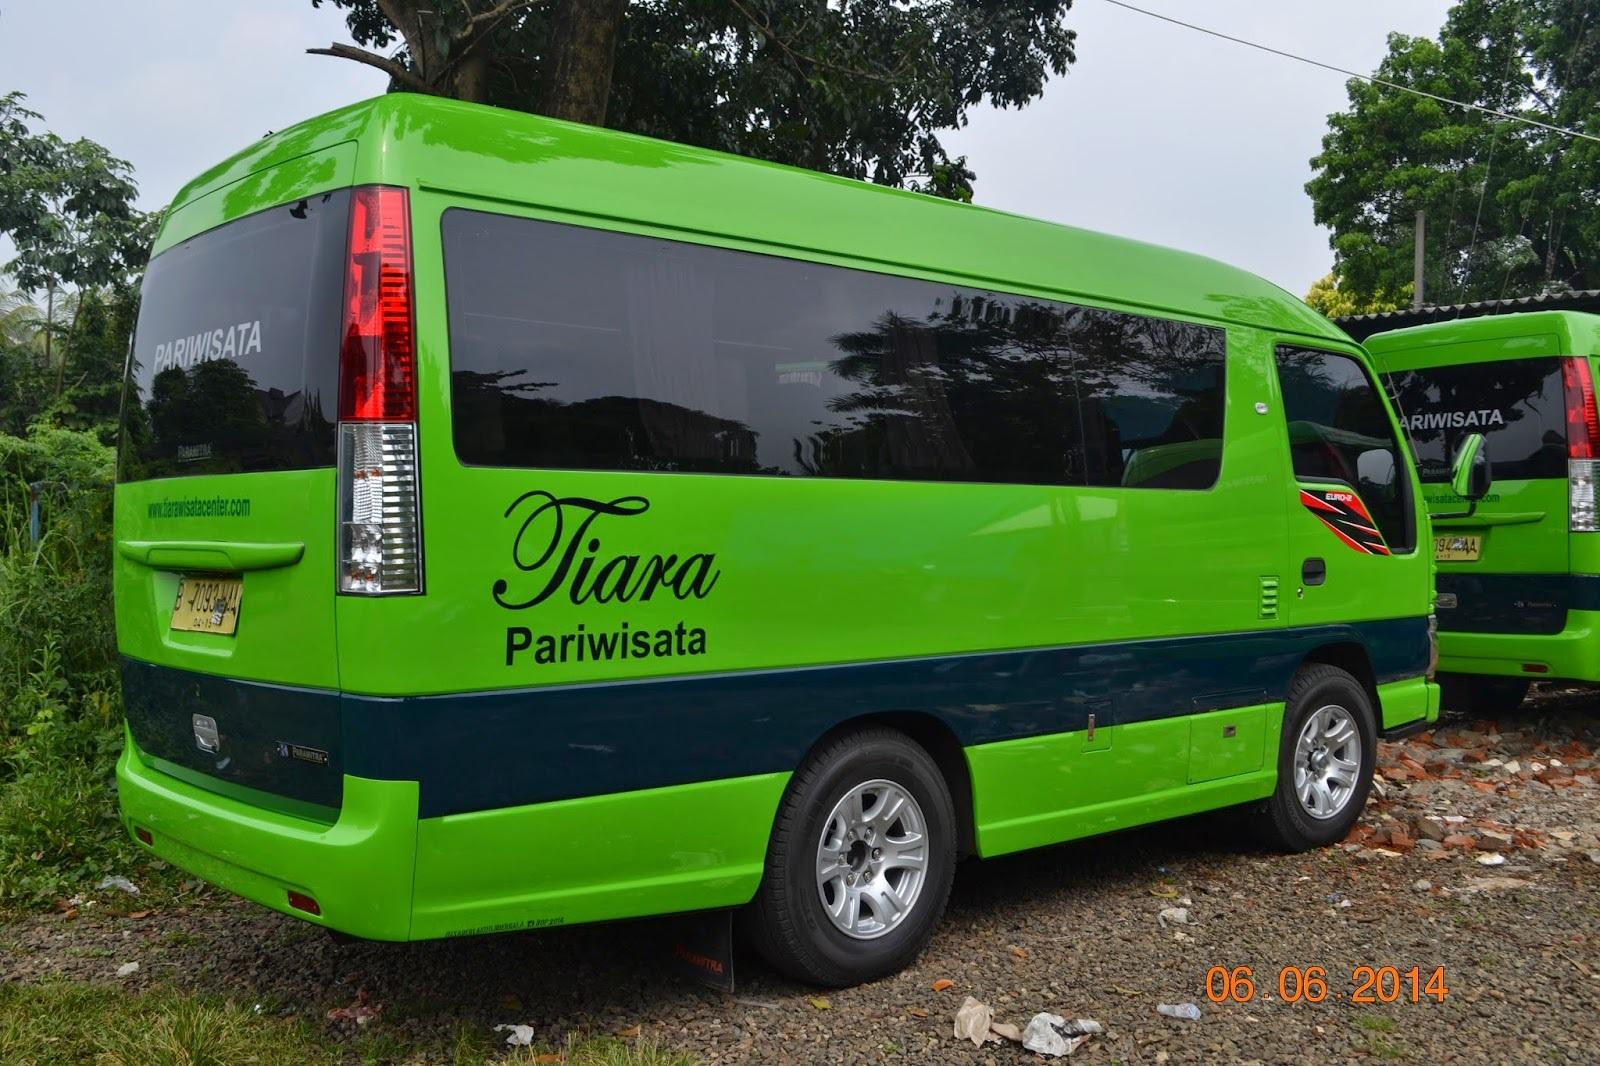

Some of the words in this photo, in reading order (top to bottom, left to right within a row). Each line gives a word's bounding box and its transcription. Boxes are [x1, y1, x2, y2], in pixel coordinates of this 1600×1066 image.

[154, 320, 262, 369] PARIWISATA
[1399, 409, 1504, 431] ARIWISATA
[492, 490, 721, 610] Tiara
[505, 621, 707, 667] Pariwisata
